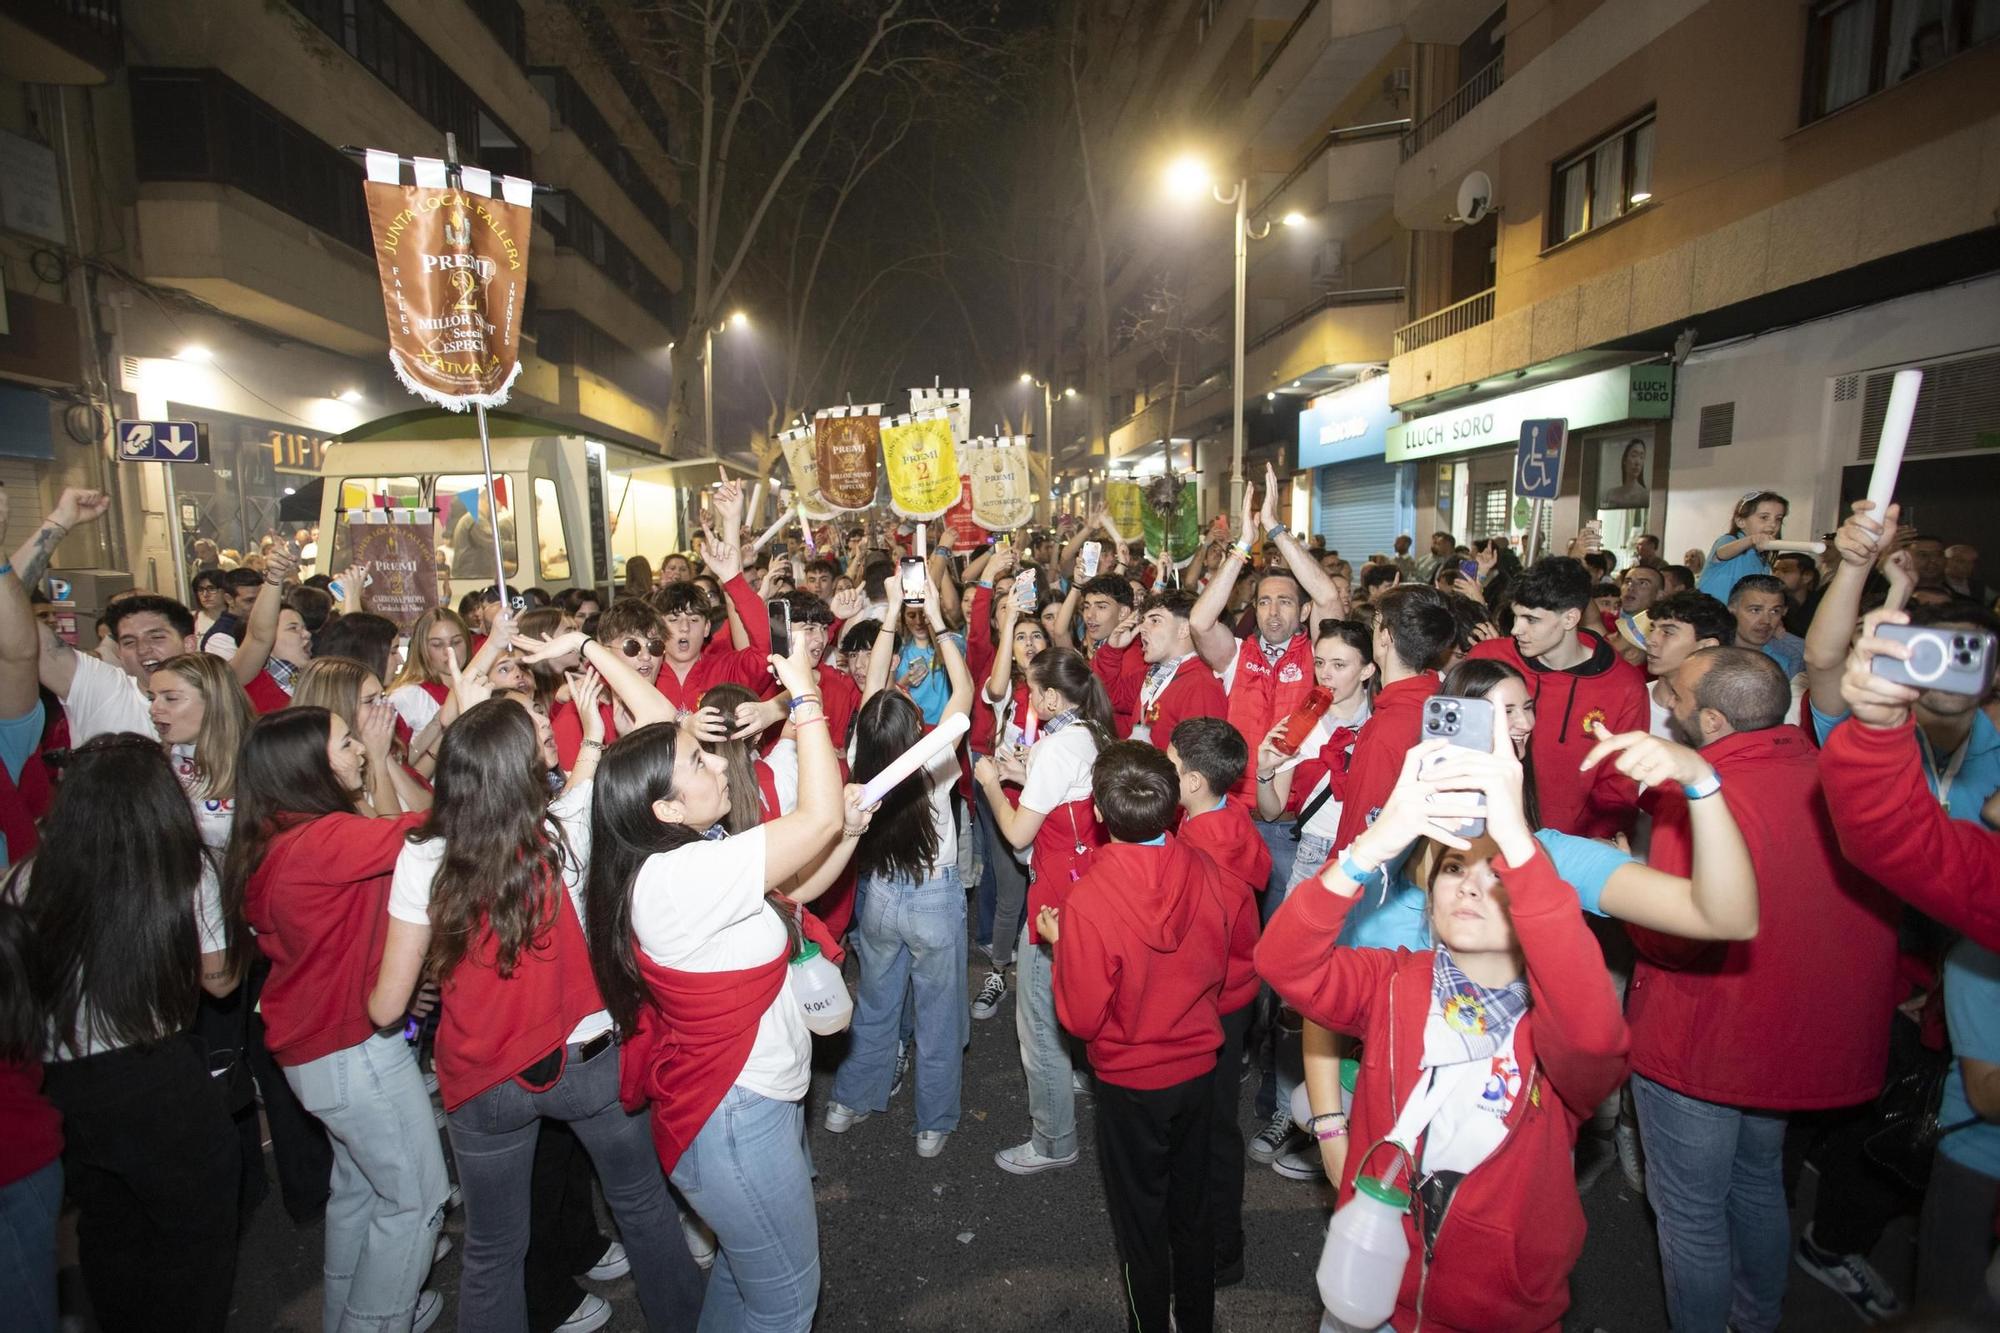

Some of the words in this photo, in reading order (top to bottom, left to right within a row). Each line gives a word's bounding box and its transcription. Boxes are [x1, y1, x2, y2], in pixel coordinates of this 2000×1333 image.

[384, 208, 417, 255] JUNTA
[417, 193, 474, 213] LOCAL
[476, 205, 521, 271] FALLERA
[451, 270, 478, 310] 2
[417, 314, 471, 330] MILLOR
[453, 327, 483, 339] Secci
[443, 340, 487, 354] ESPECI
[1632, 381, 1667, 391] LLUCH
[1406, 425, 1444, 449] LLUCH
[832, 443, 866, 455] PREMI
[902, 449, 938, 465] PREMI
[916, 462, 930, 480] 2
[984, 473, 1015, 483] PREMI
[375, 560, 417, 572] PREMI
